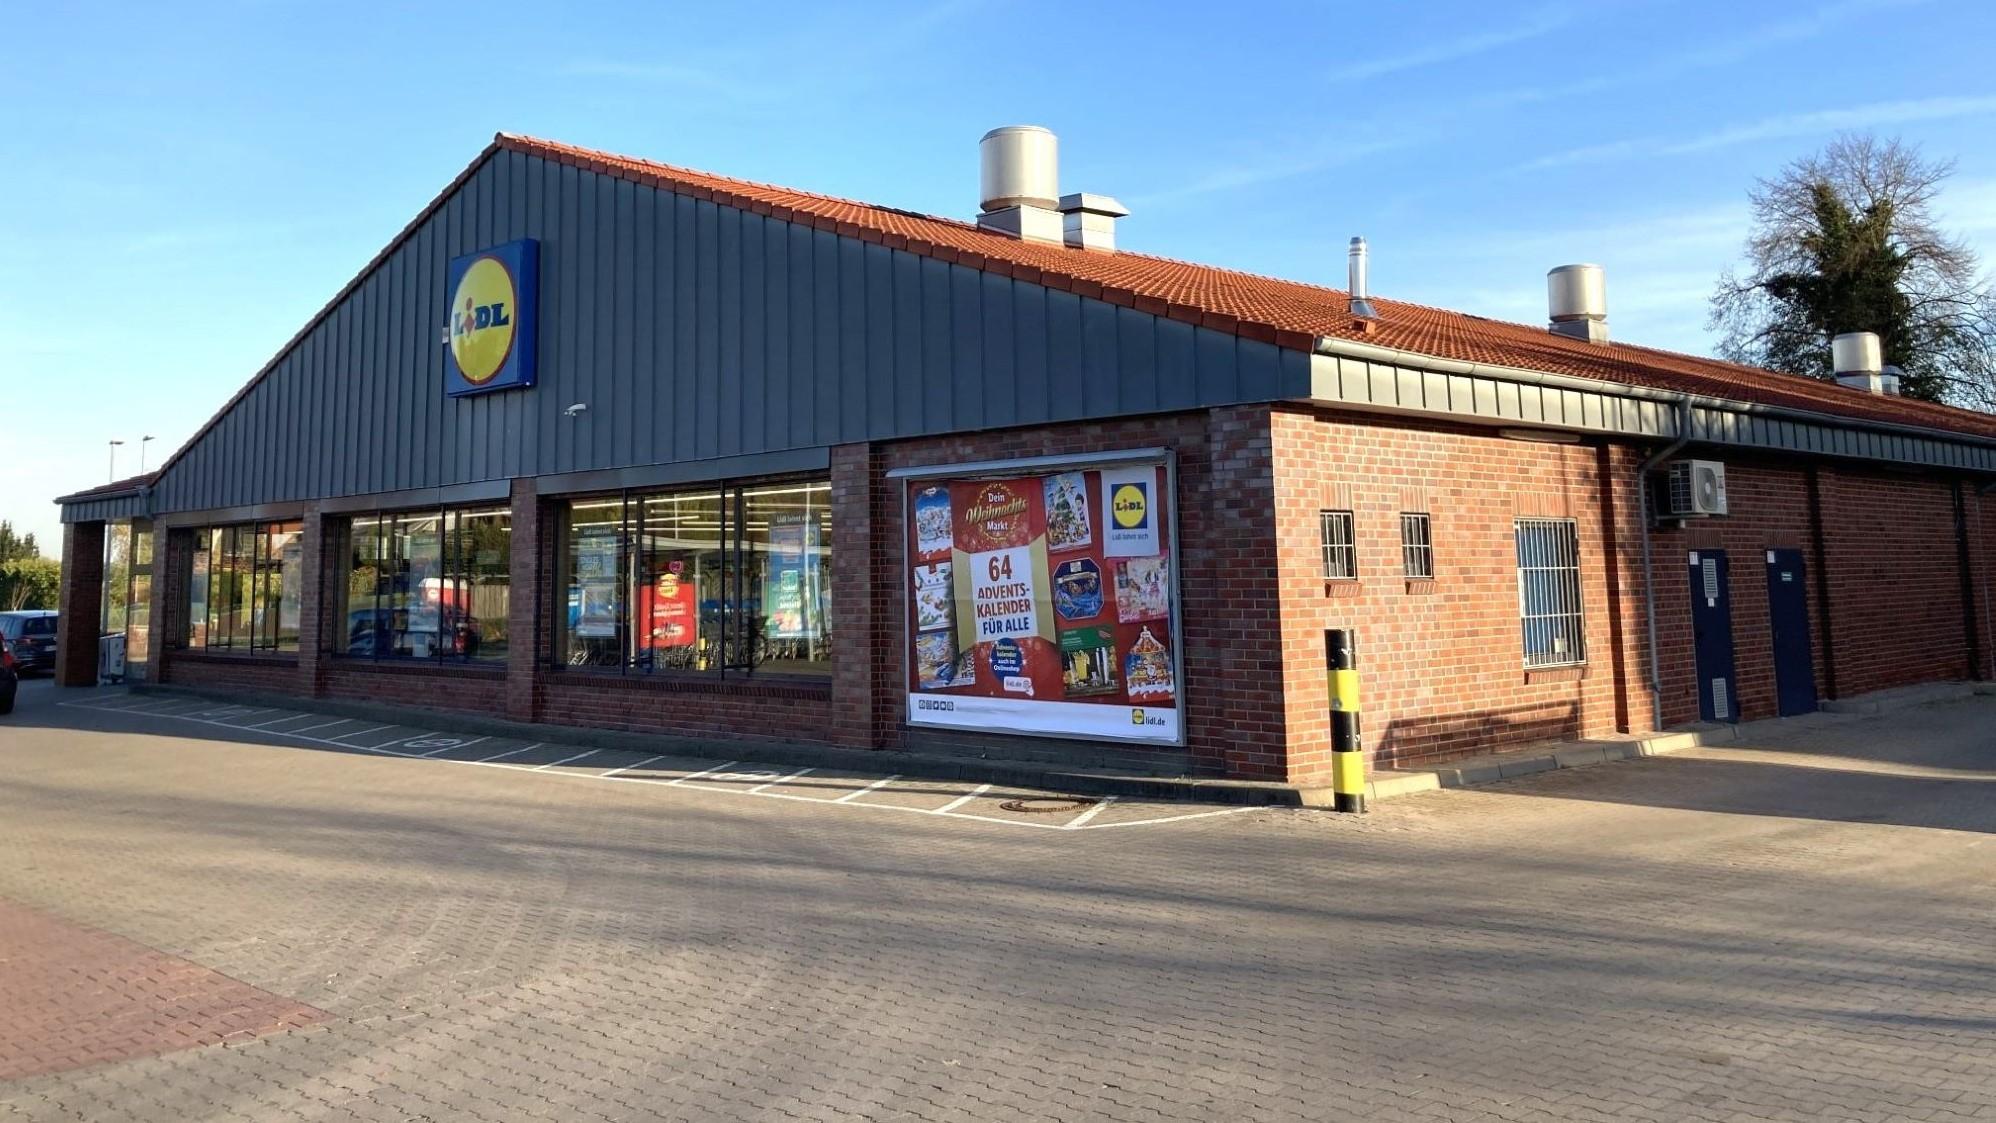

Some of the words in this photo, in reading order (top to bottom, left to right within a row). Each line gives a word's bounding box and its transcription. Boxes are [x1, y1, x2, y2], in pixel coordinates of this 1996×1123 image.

[988, 492, 1005, 502] Dein
[965, 497, 1027, 525] Weihnachts
[986, 520, 1008, 531] Markt
[988, 554, 1012, 581] 64
[978, 583, 1030, 599] ADVENTS-
[976, 599, 1031, 618] KALENDER
[983, 618, 1003, 635] FÜR
[1005, 617, 1030, 632] ALLE
[1145, 717, 1166, 726] lidl.de
